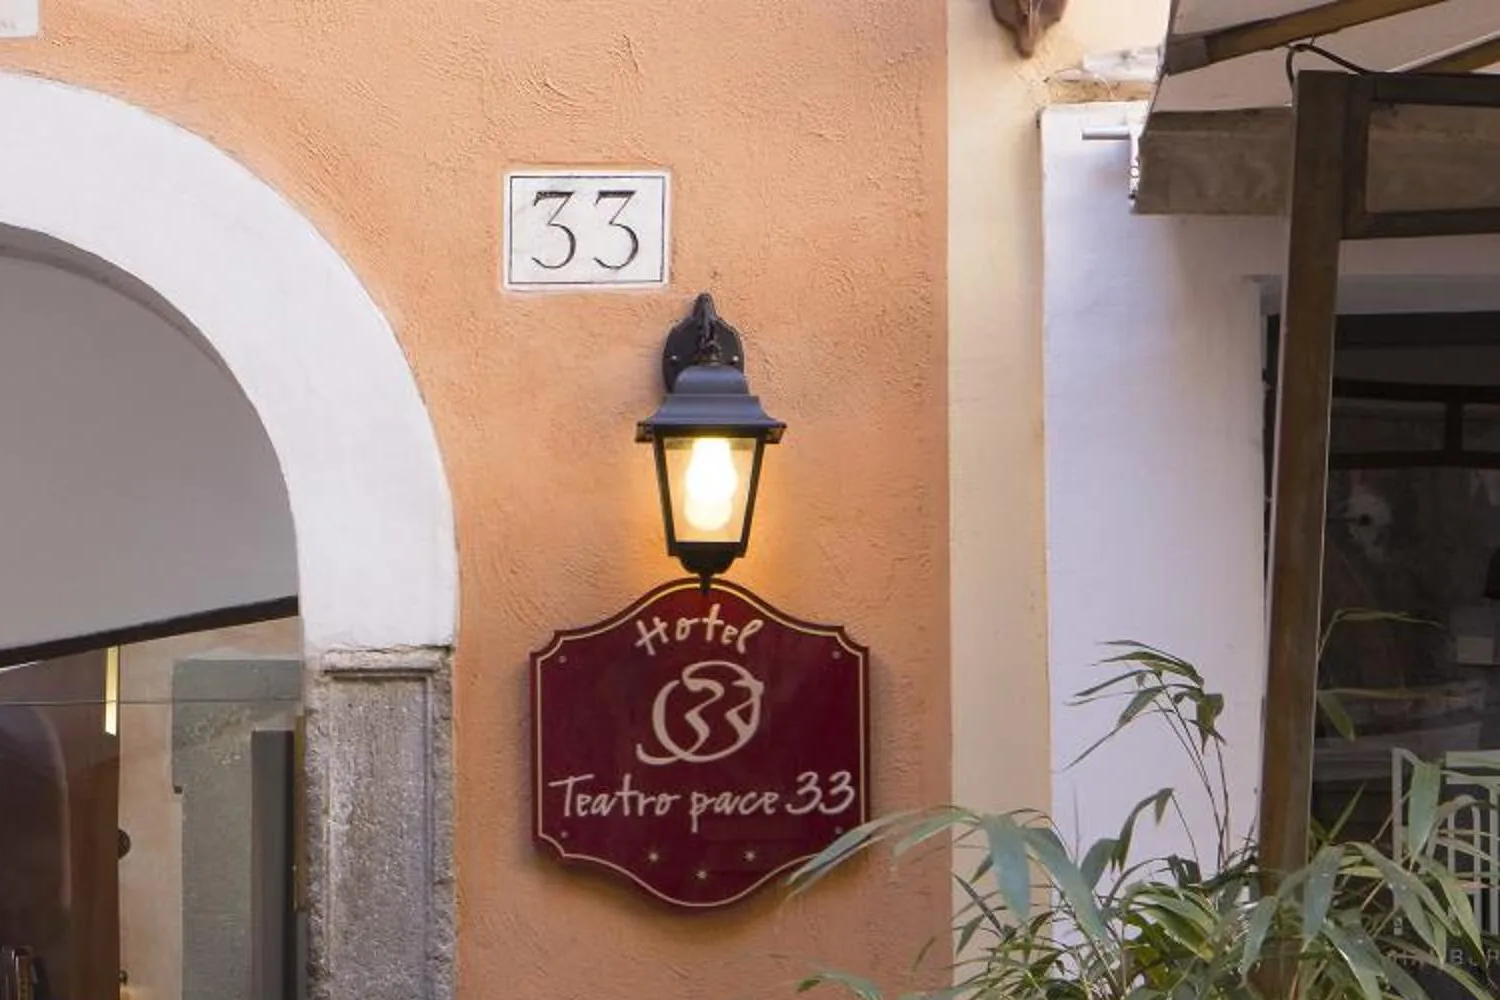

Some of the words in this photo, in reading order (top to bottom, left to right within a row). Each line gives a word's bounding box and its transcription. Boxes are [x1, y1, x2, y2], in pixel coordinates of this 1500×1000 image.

[531, 189, 639, 269] 33
[635, 603, 764, 655] Hotel
[548, 773, 681, 816] Teatro
[689, 791, 779, 833] pace
[785, 771, 855, 814] 33
